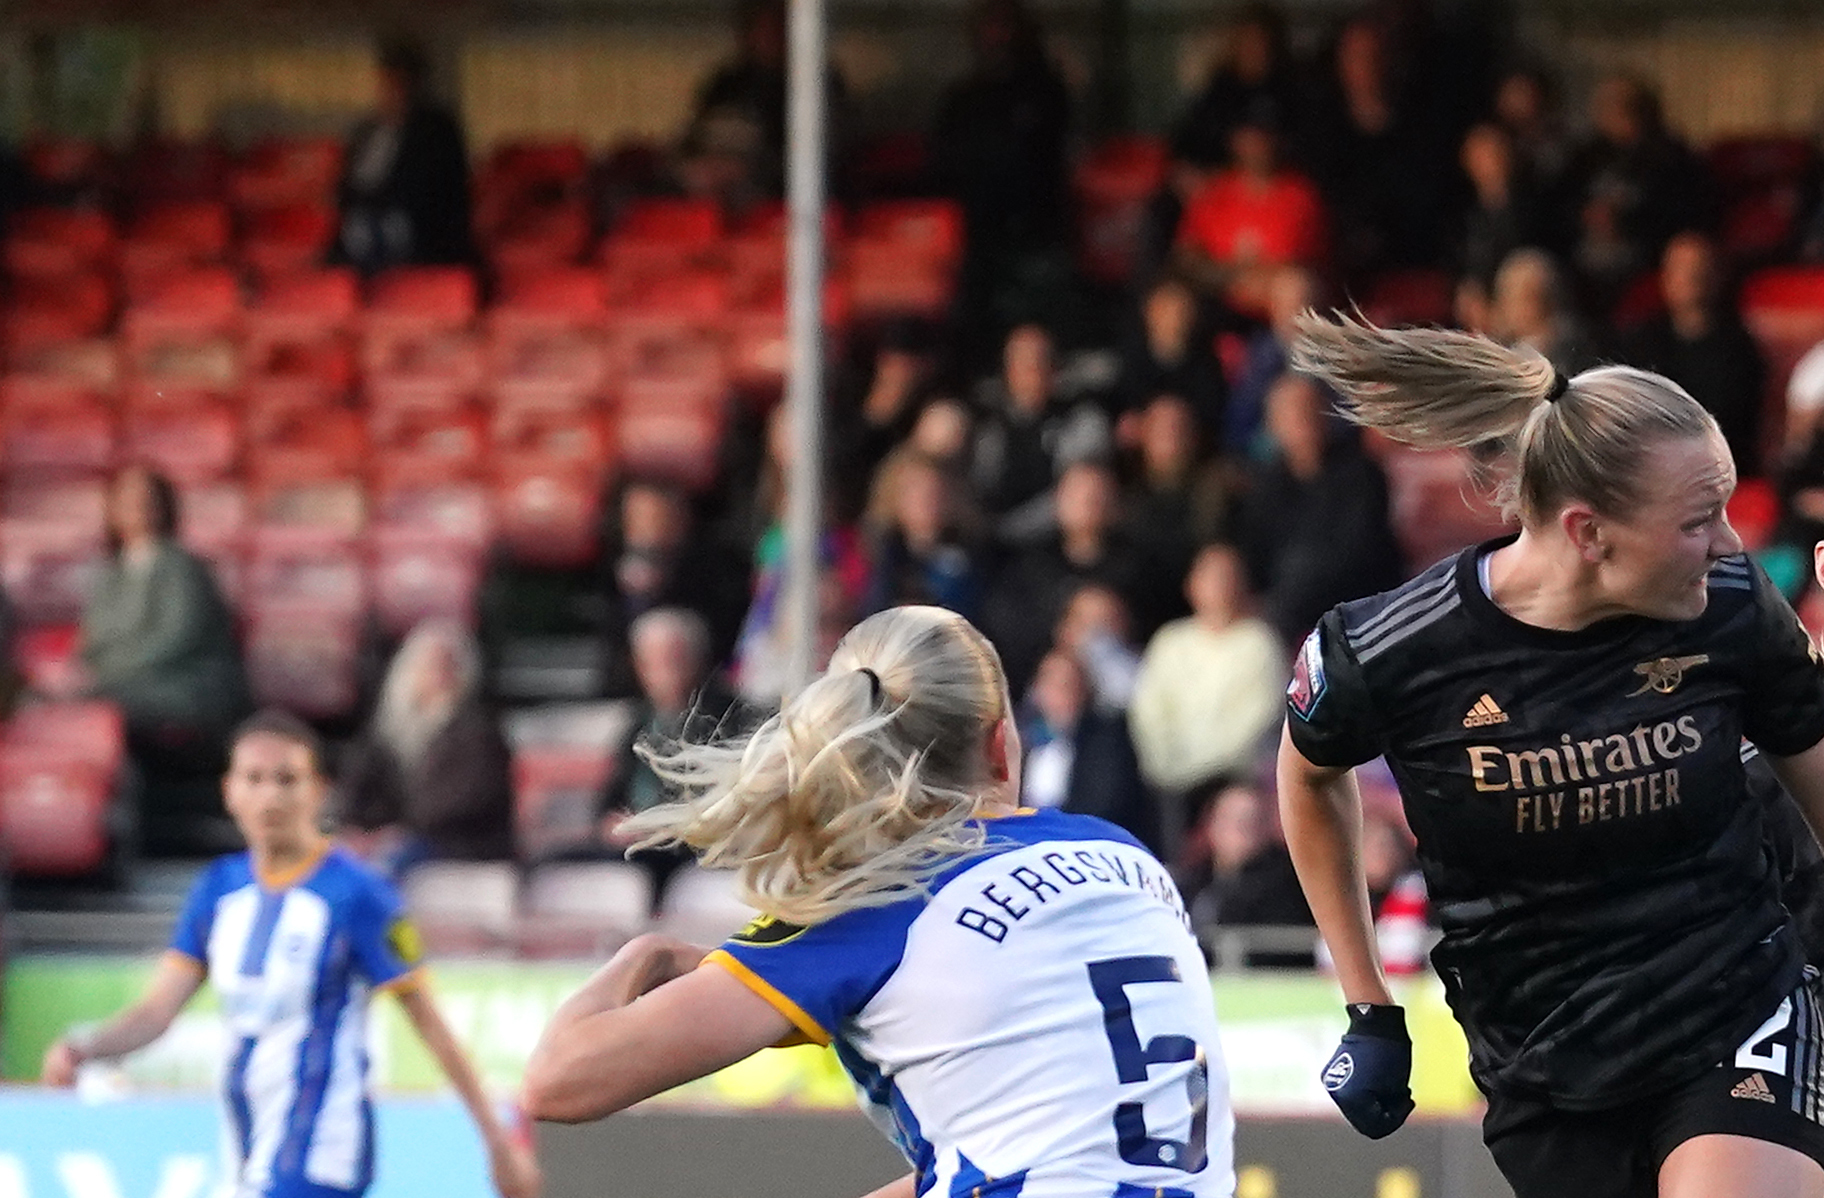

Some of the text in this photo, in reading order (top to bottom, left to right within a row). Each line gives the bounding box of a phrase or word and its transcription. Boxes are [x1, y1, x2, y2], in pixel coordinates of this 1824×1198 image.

[1466, 714, 1702, 792] Emirates
[1516, 767, 1682, 834] FLY BETTER
[1084, 953, 1209, 1174] 5
